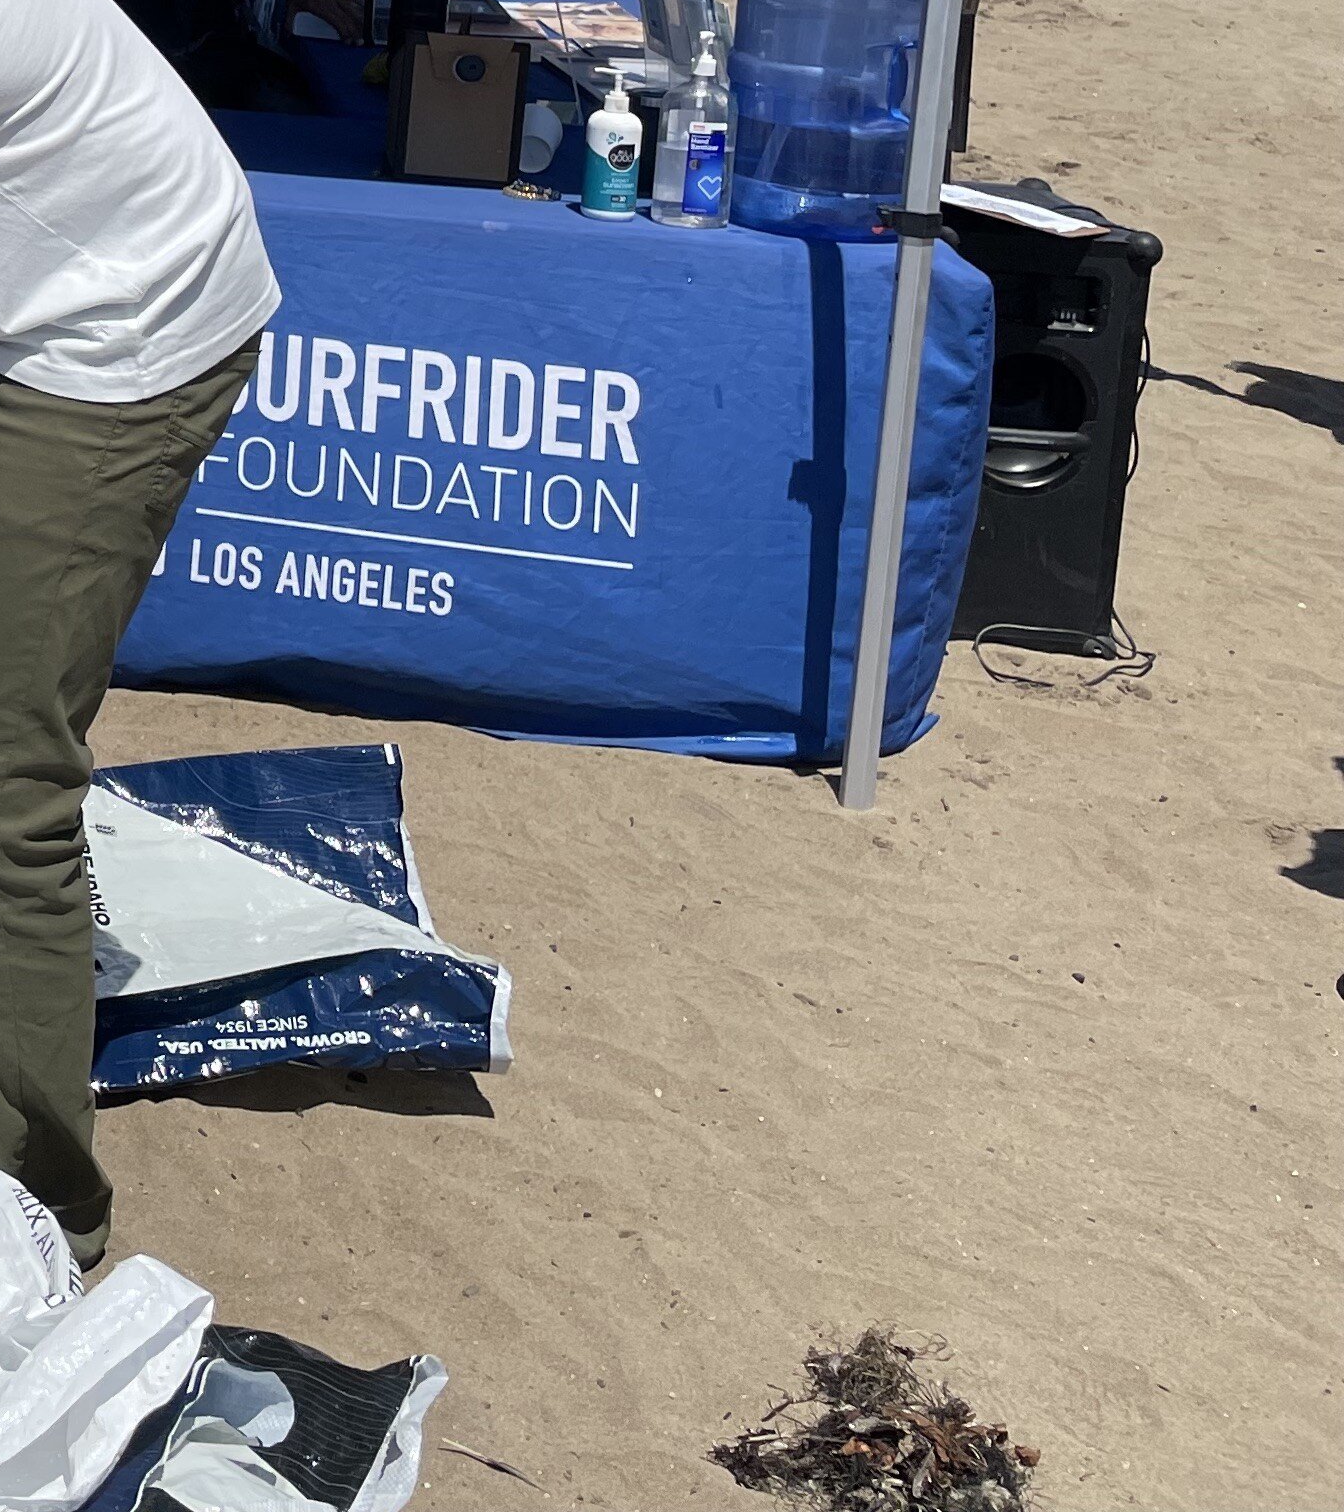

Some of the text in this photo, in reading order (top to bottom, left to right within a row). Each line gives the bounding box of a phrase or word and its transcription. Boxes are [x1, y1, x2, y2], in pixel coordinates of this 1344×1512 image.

[232, 332, 641, 465] URFRIDER
[197, 433, 639, 538] FOUNDATION
[189, 538, 455, 616] LOS ANGELES
[158, 1031, 371, 1055] GROWN. MALTED. USA.
[215, 1015, 308, 1034] SINCE 1934
